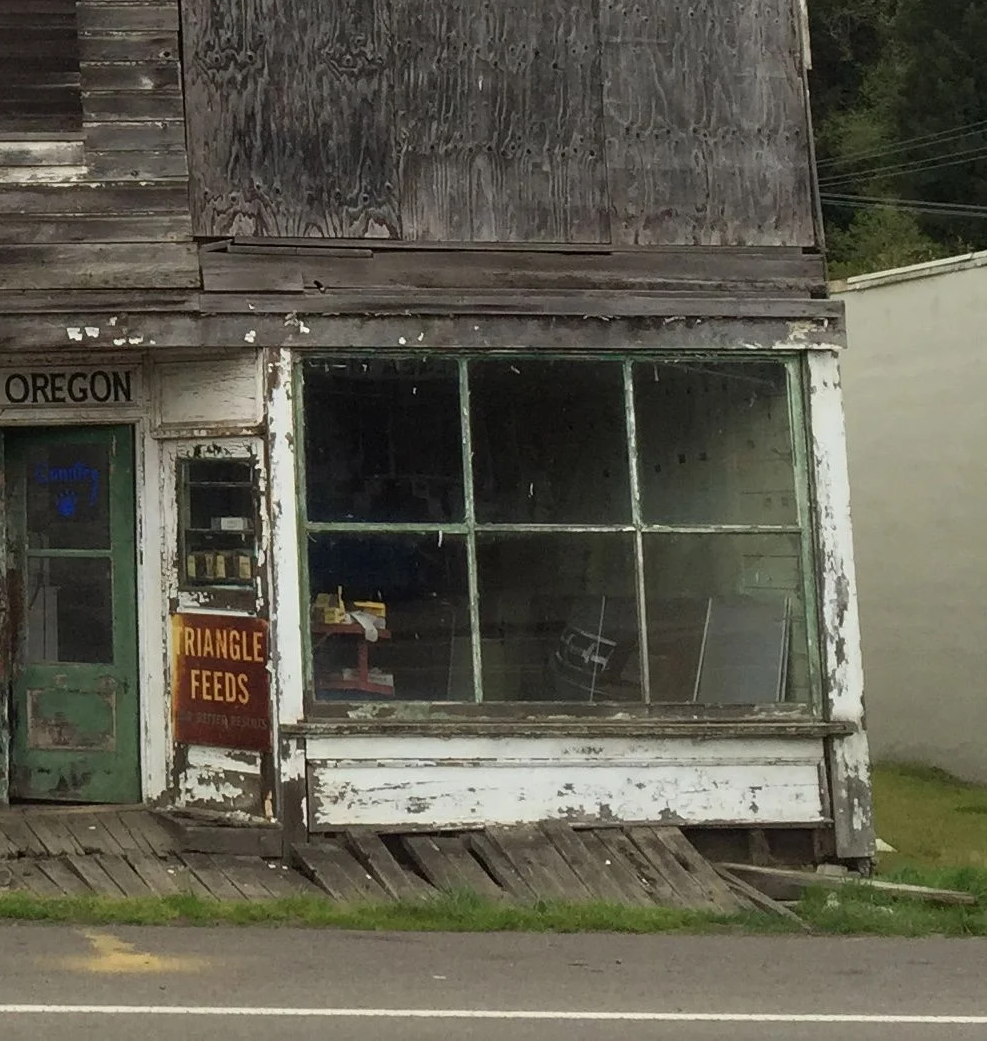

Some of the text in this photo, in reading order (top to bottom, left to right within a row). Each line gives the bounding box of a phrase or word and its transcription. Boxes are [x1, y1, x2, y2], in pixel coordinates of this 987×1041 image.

[4, 370, 132, 404] OREGON
[173, 626, 264, 662] TRIANGLE
[190, 669, 250, 704] FEEDS
